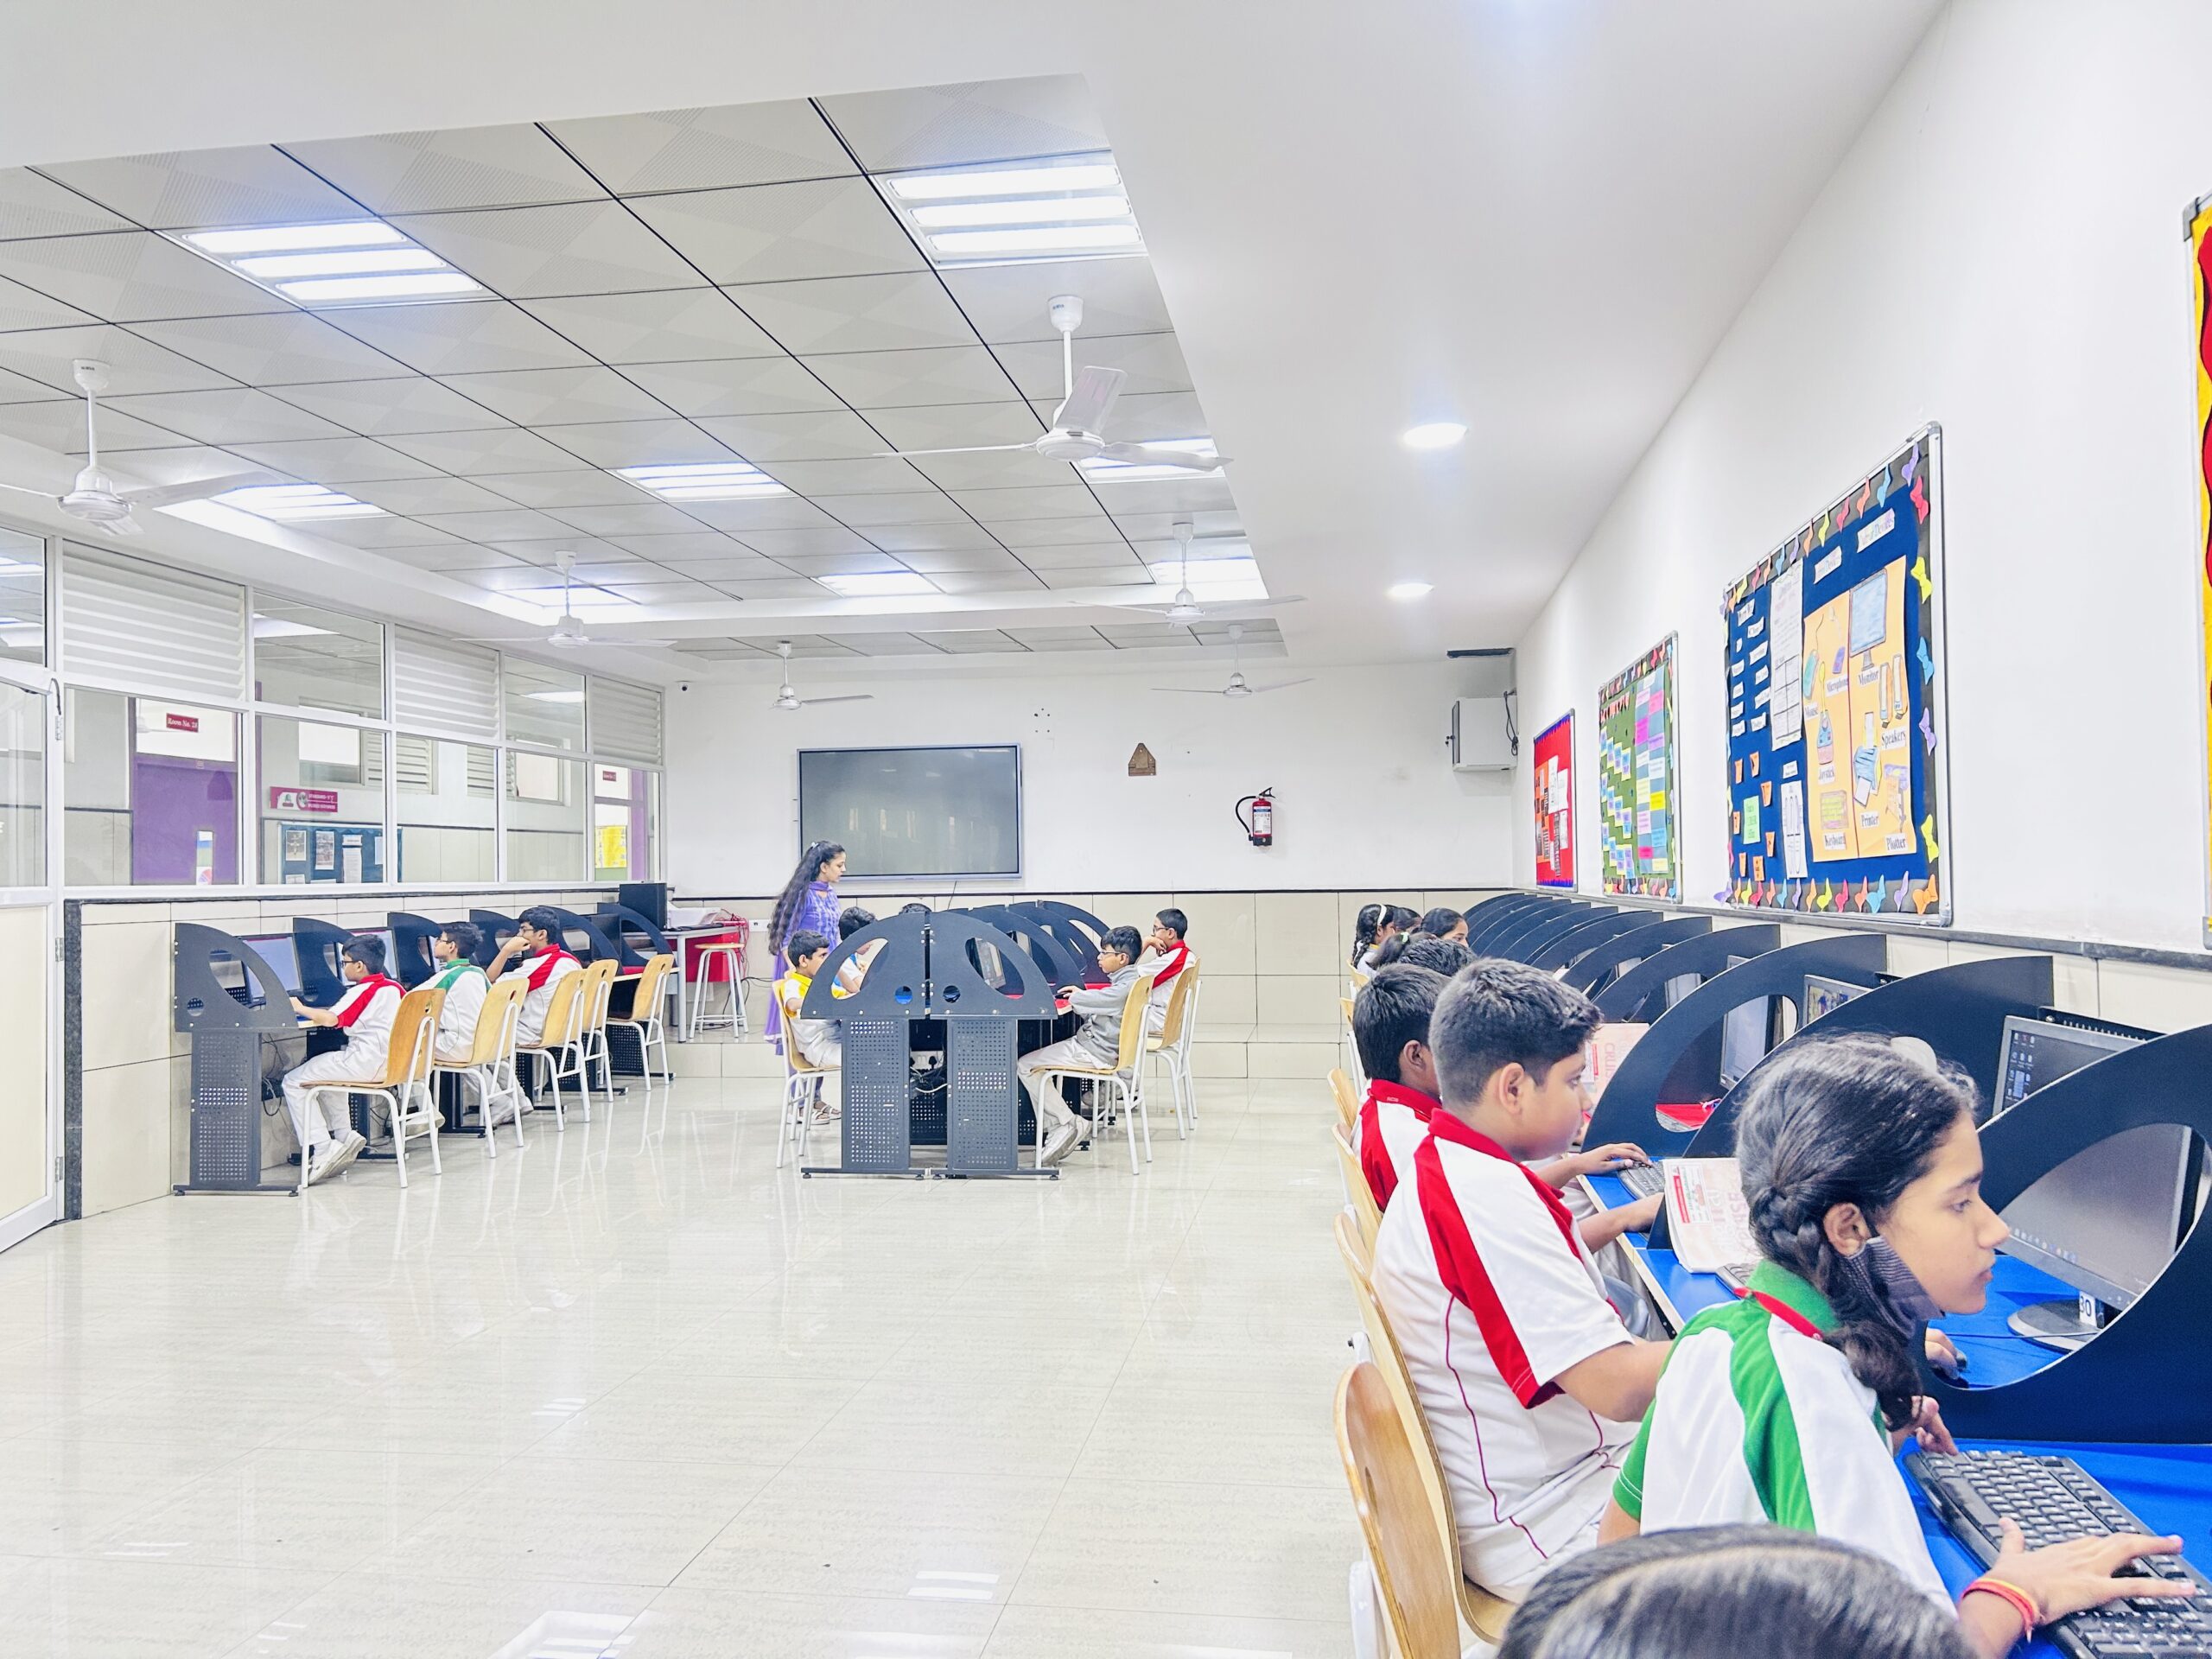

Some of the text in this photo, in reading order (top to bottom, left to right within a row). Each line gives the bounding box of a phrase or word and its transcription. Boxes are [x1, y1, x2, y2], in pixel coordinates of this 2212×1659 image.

[1859, 671, 1879, 685] Monitor
[168, 717, 181, 726] Room
[1882, 730, 1906, 749] Speakers
[1861, 815, 1878, 828] Printer
[1886, 836, 1906, 850] Plotter
[1605, 1042, 1617, 1081] CRUIS
